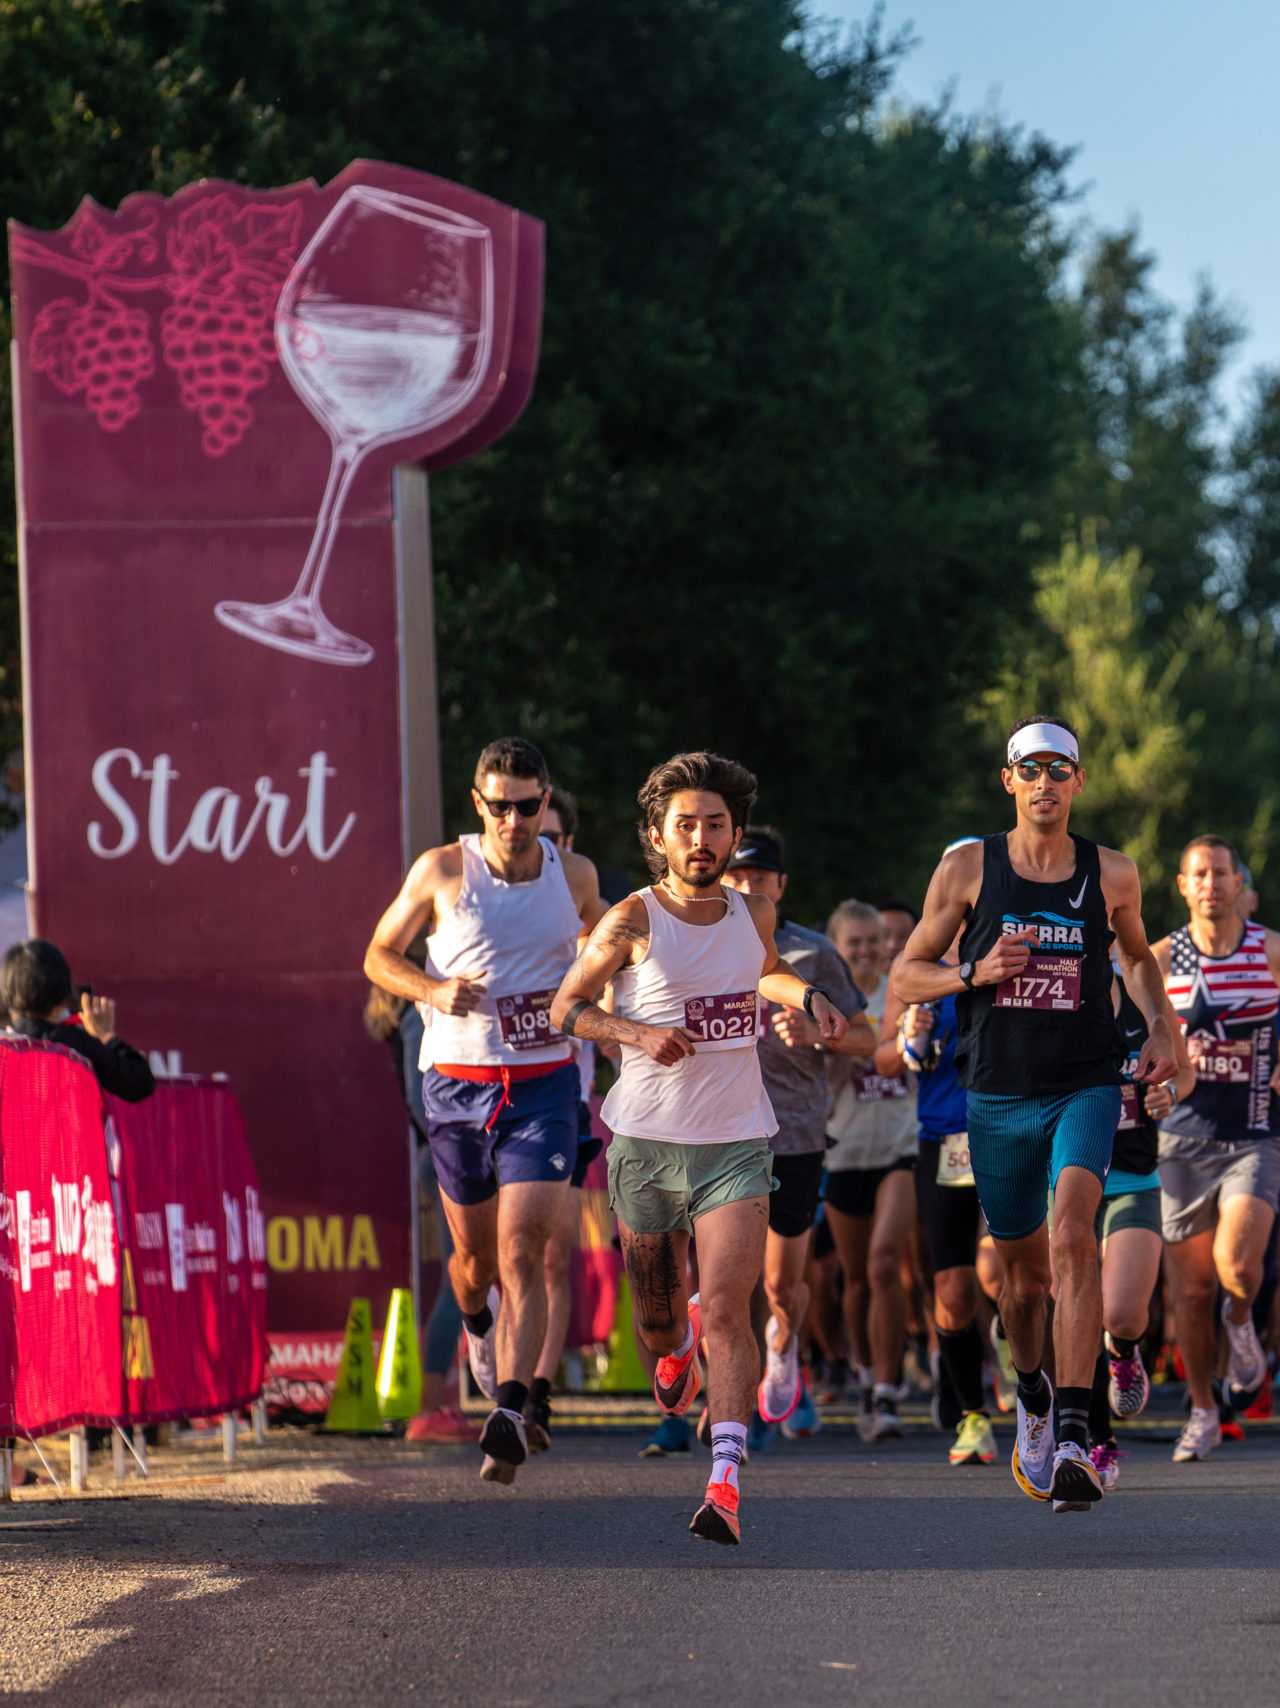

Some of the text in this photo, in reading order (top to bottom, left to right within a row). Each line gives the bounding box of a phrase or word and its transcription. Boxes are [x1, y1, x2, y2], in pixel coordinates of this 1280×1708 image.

[87, 748, 357, 866] Start
[1052, 943, 1083, 951] SPORTS
[1037, 964, 1078, 973] MARATHON
[1013, 977, 1066, 998] 1774
[512, 1009, 550, 1032] 108
[699, 1015, 753, 1040] 1022
[1257, 1026, 1272, 1049] US
[1253, 1055, 1271, 1131] MILITARY
